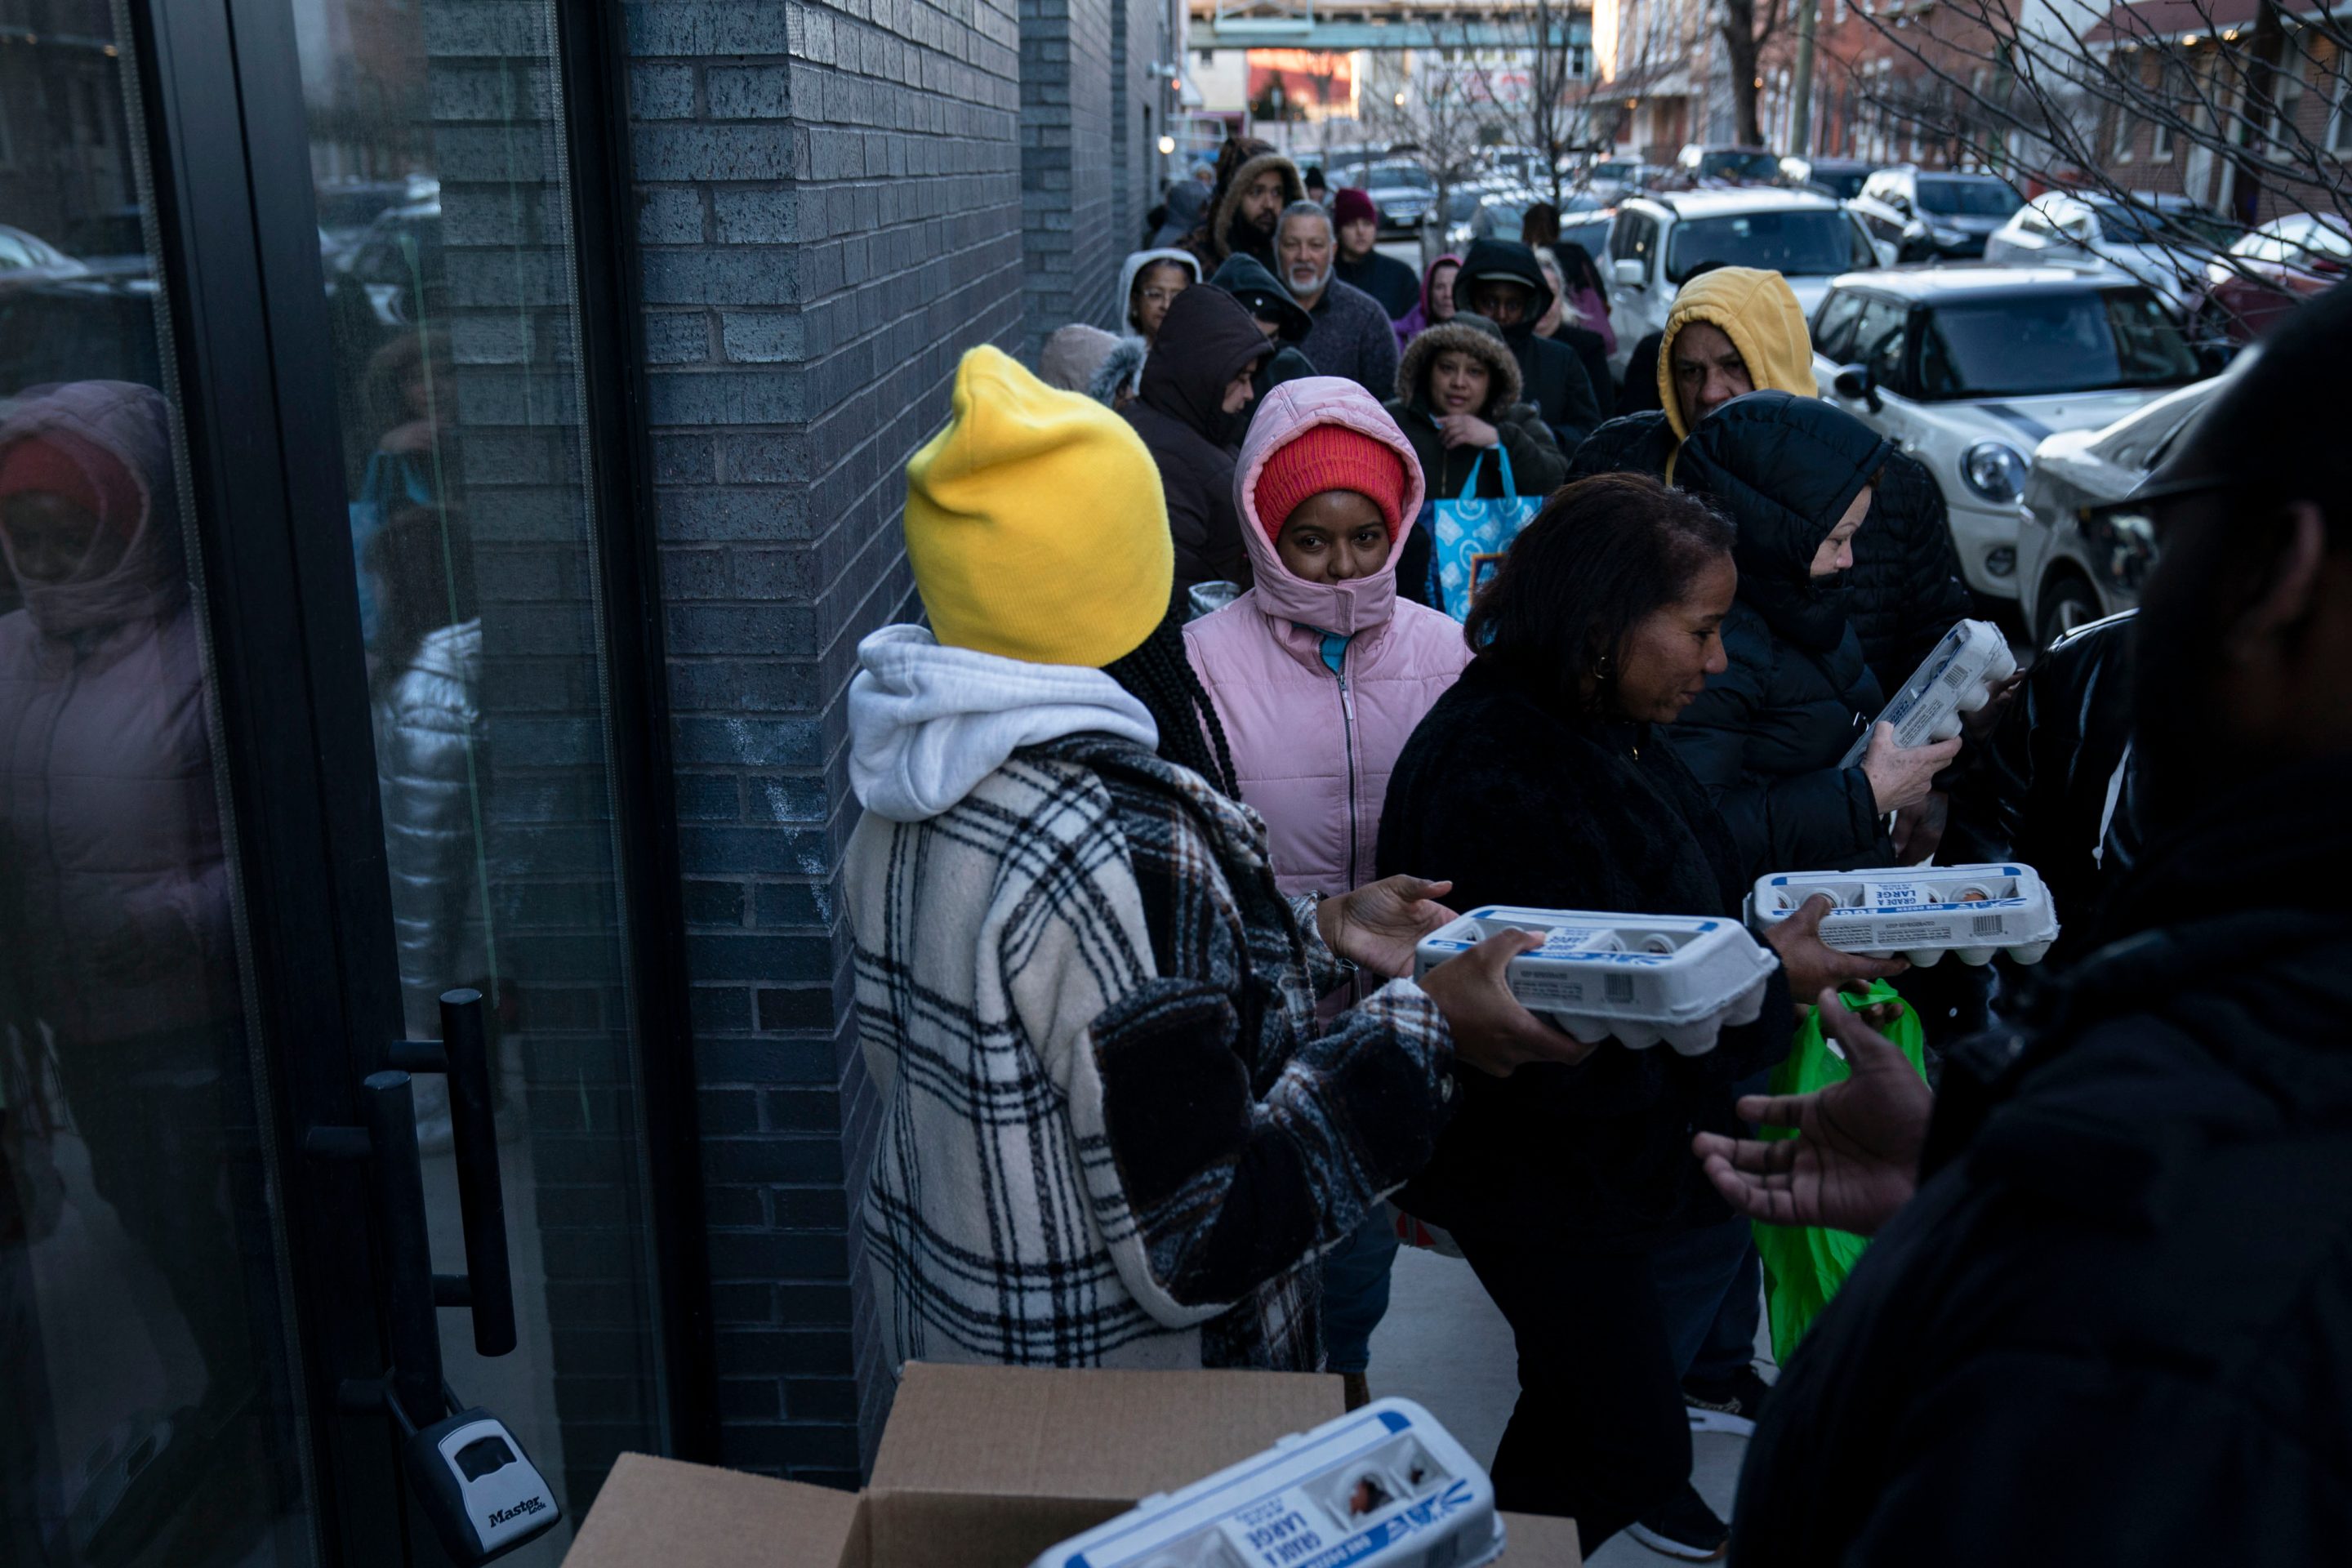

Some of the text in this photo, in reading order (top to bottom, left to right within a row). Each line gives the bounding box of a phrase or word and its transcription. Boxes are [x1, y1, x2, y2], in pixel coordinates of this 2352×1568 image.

[1876, 890, 1916, 898] LARGE
[1886, 898, 1916, 906] GRADE
[488, 1495, 540, 1528] Master
[529, 1502, 546, 1515] Lock
[1248, 1510, 1307, 1549] LARGE
